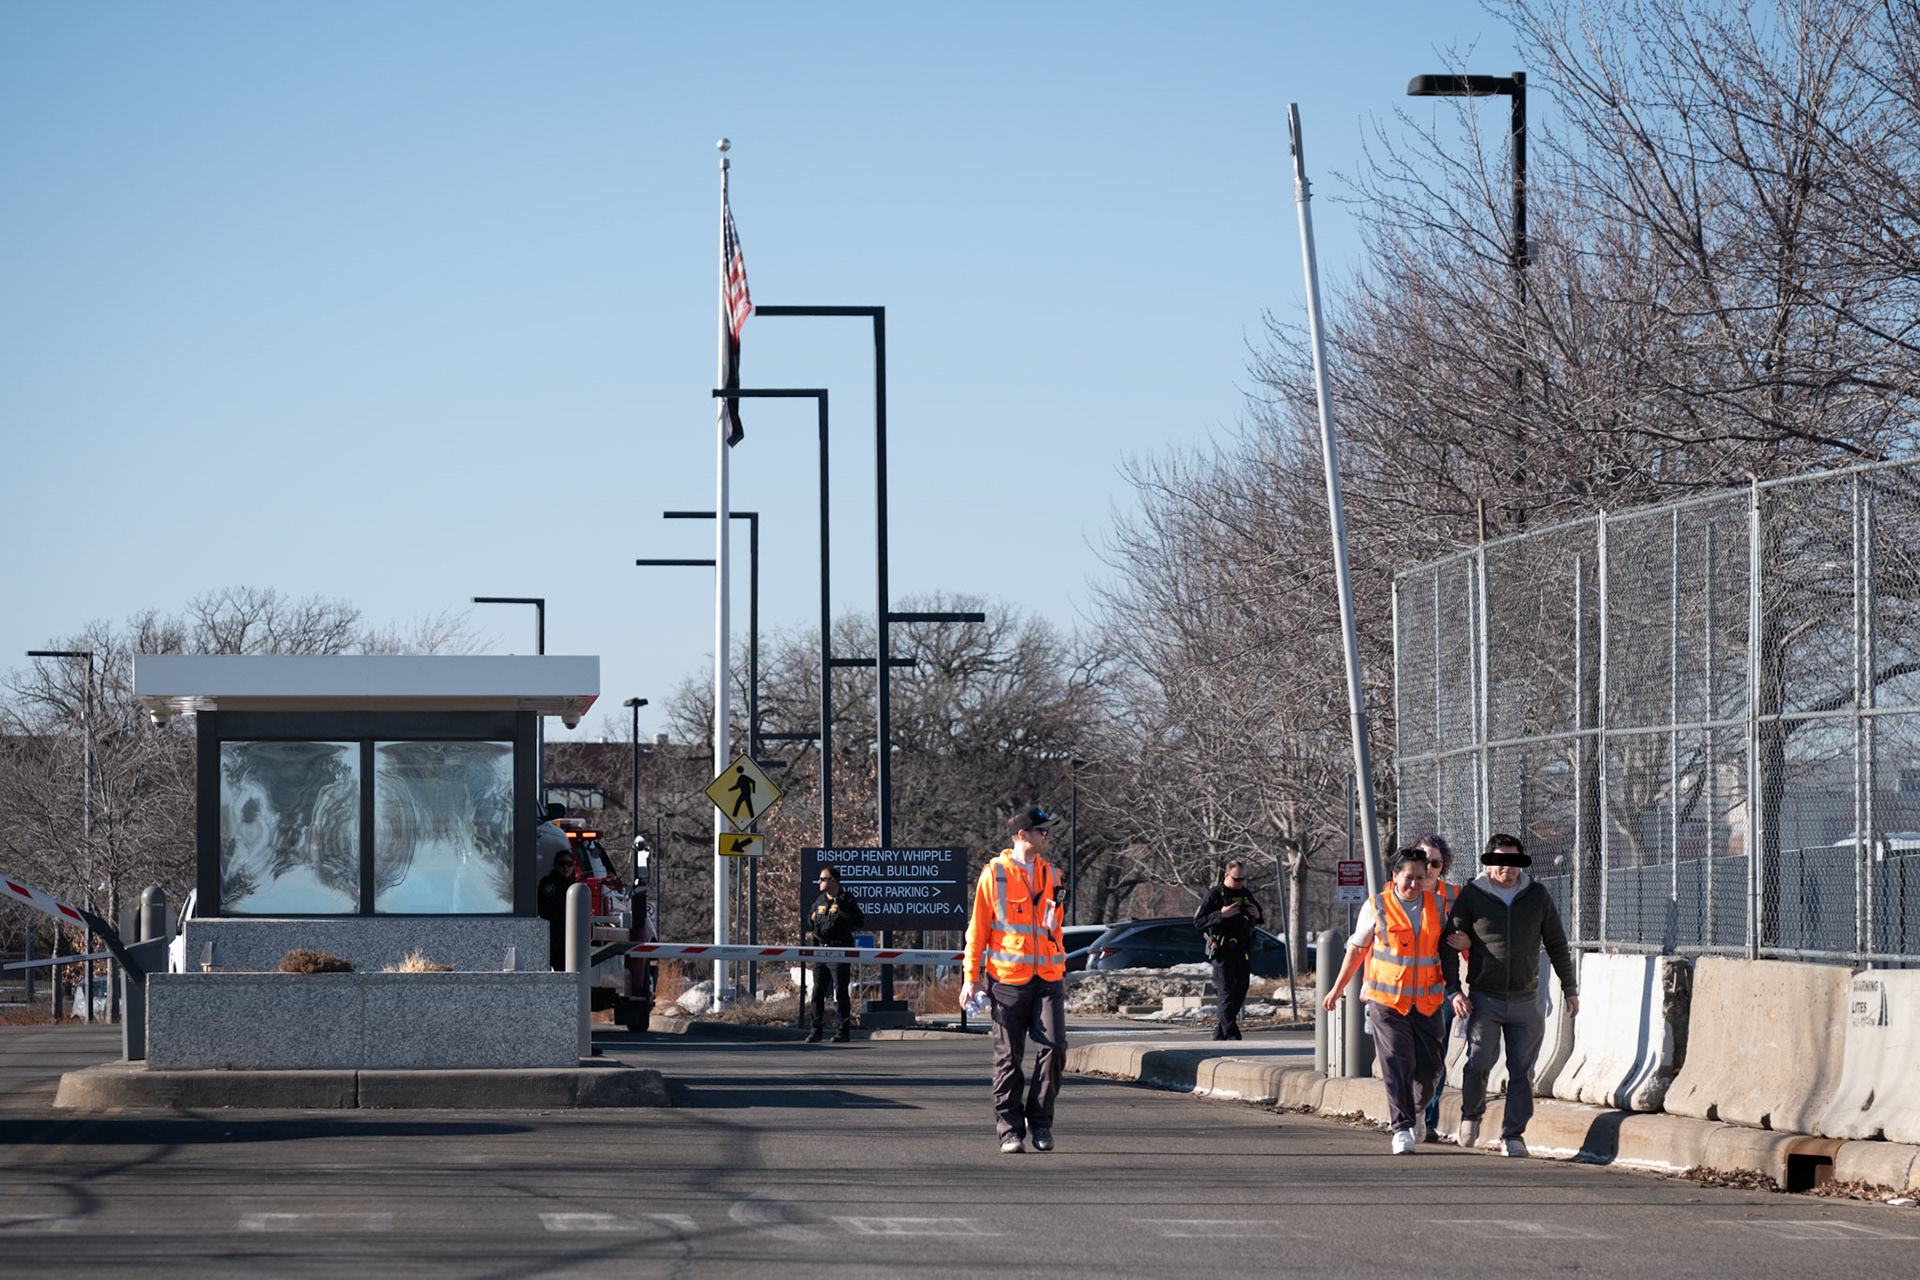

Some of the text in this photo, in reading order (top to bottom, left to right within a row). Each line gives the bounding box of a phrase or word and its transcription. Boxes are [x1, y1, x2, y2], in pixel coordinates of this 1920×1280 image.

[817, 850, 952, 862] BISHOP HENRY WHIPPLE
[887, 865, 939, 877] BUILDING
[885, 886, 929, 898] PARKING
[882, 902, 904, 914] AND
[906, 902, 950, 914] PICKUPS
